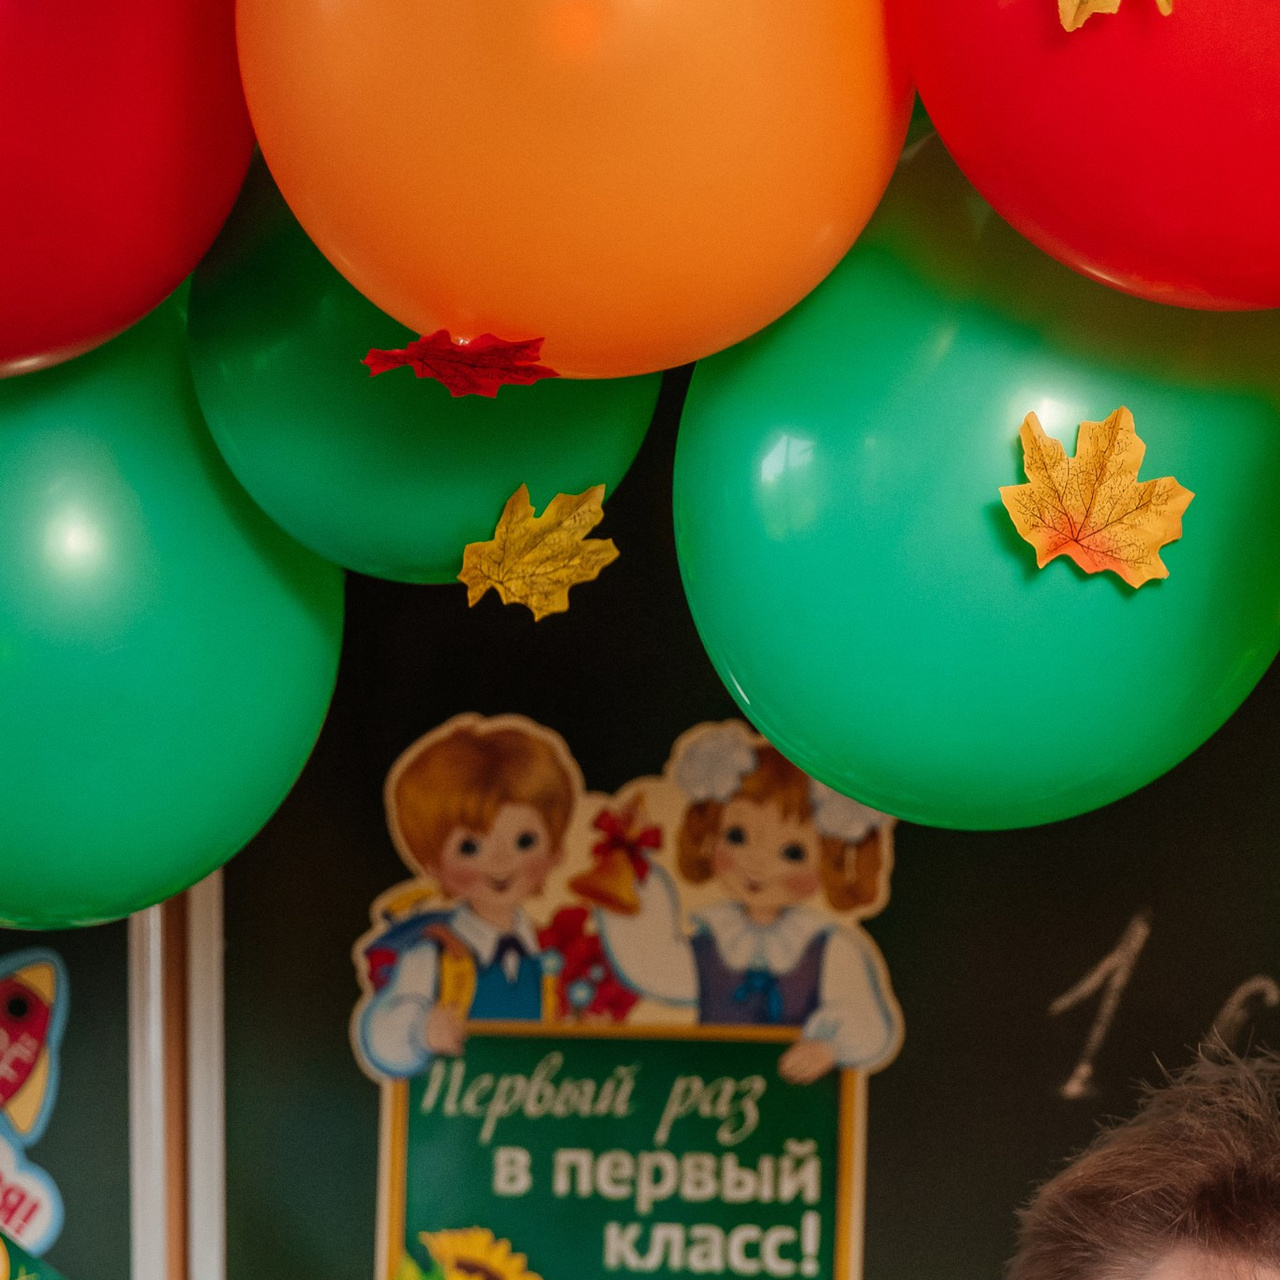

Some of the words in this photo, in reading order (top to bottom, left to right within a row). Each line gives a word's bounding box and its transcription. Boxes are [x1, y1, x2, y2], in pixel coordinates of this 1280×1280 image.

[1048, 908, 1152, 1100] 1
[419, 1050, 640, 1146] Первый
[653, 1070, 768, 1147] раз
[493, 1146, 533, 1197] в
[552, 1138, 822, 1216] первый
[603, 1210, 821, 1278] класс!
